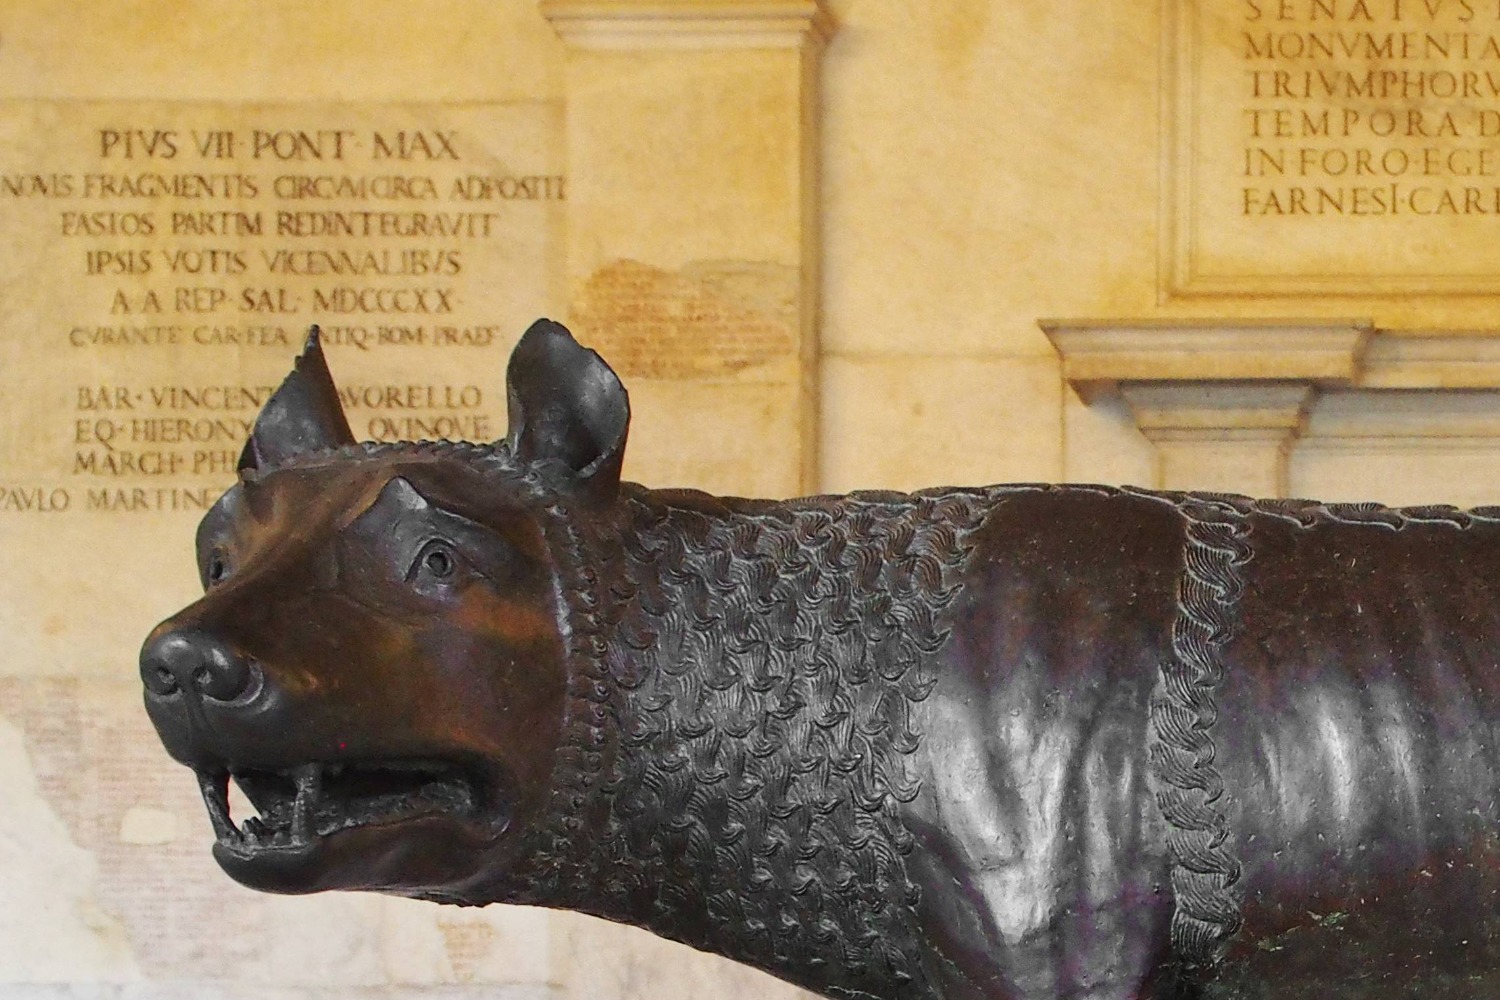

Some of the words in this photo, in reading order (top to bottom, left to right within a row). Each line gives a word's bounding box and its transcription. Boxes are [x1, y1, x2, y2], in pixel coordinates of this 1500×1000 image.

[1243, 108, 1461, 137] TEMPORA
[100, 129, 178, 160] PIVS
[189, 129, 235, 159] VII
[251, 129, 355, 161] PONT
[372, 130, 460, 161] MAX
[1243, 148, 1285, 177] IN
[1300, 148, 1410, 177] FORO
[82, 174, 258, 198] FRAGMENTIS
[1241, 182, 1399, 216] FARNESI
[86, 250, 151, 275] IPSIS
[161, 249, 247, 274] VOTIS
[174, 287, 226, 312] REP
[240, 288, 297, 313] SAL
